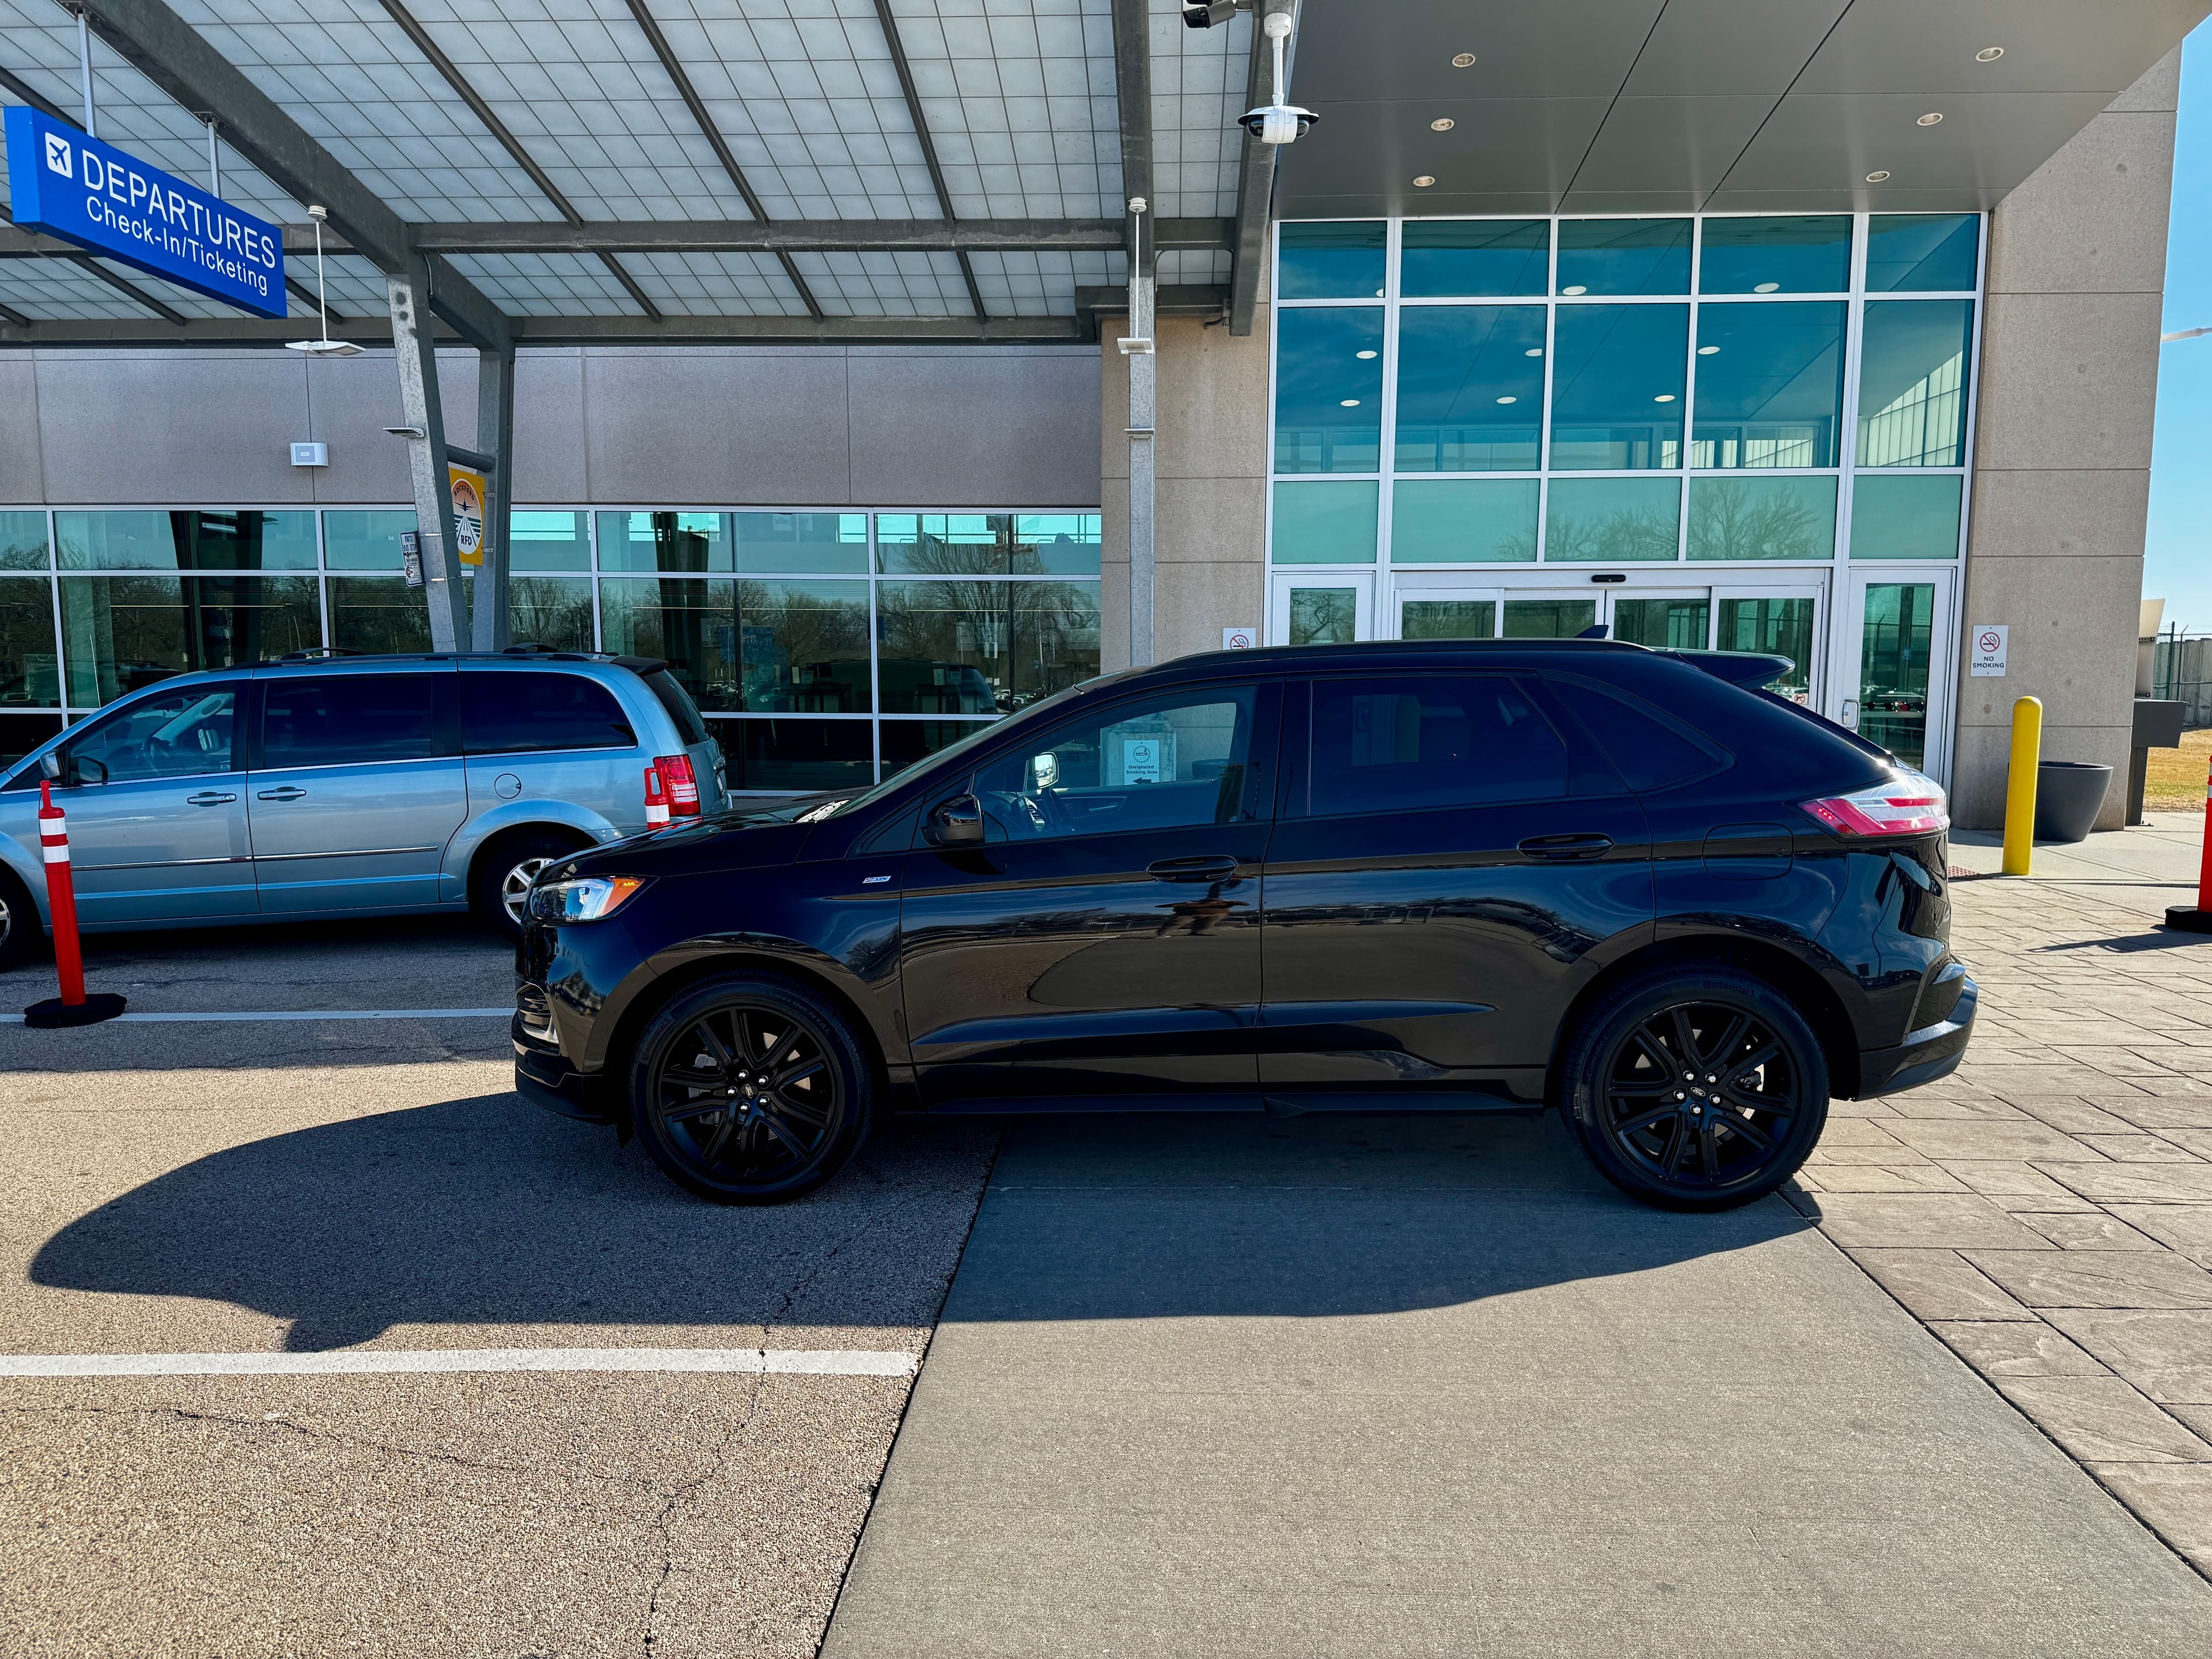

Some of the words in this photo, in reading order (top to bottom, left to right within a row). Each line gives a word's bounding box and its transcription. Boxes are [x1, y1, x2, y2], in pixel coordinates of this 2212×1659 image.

[82, 149, 276, 269] DEPARTURES
[86, 196, 267, 296] Check-In/Ticketing
[454, 485, 475, 501] ROCKFORD
[461, 535, 472, 546] RFD
